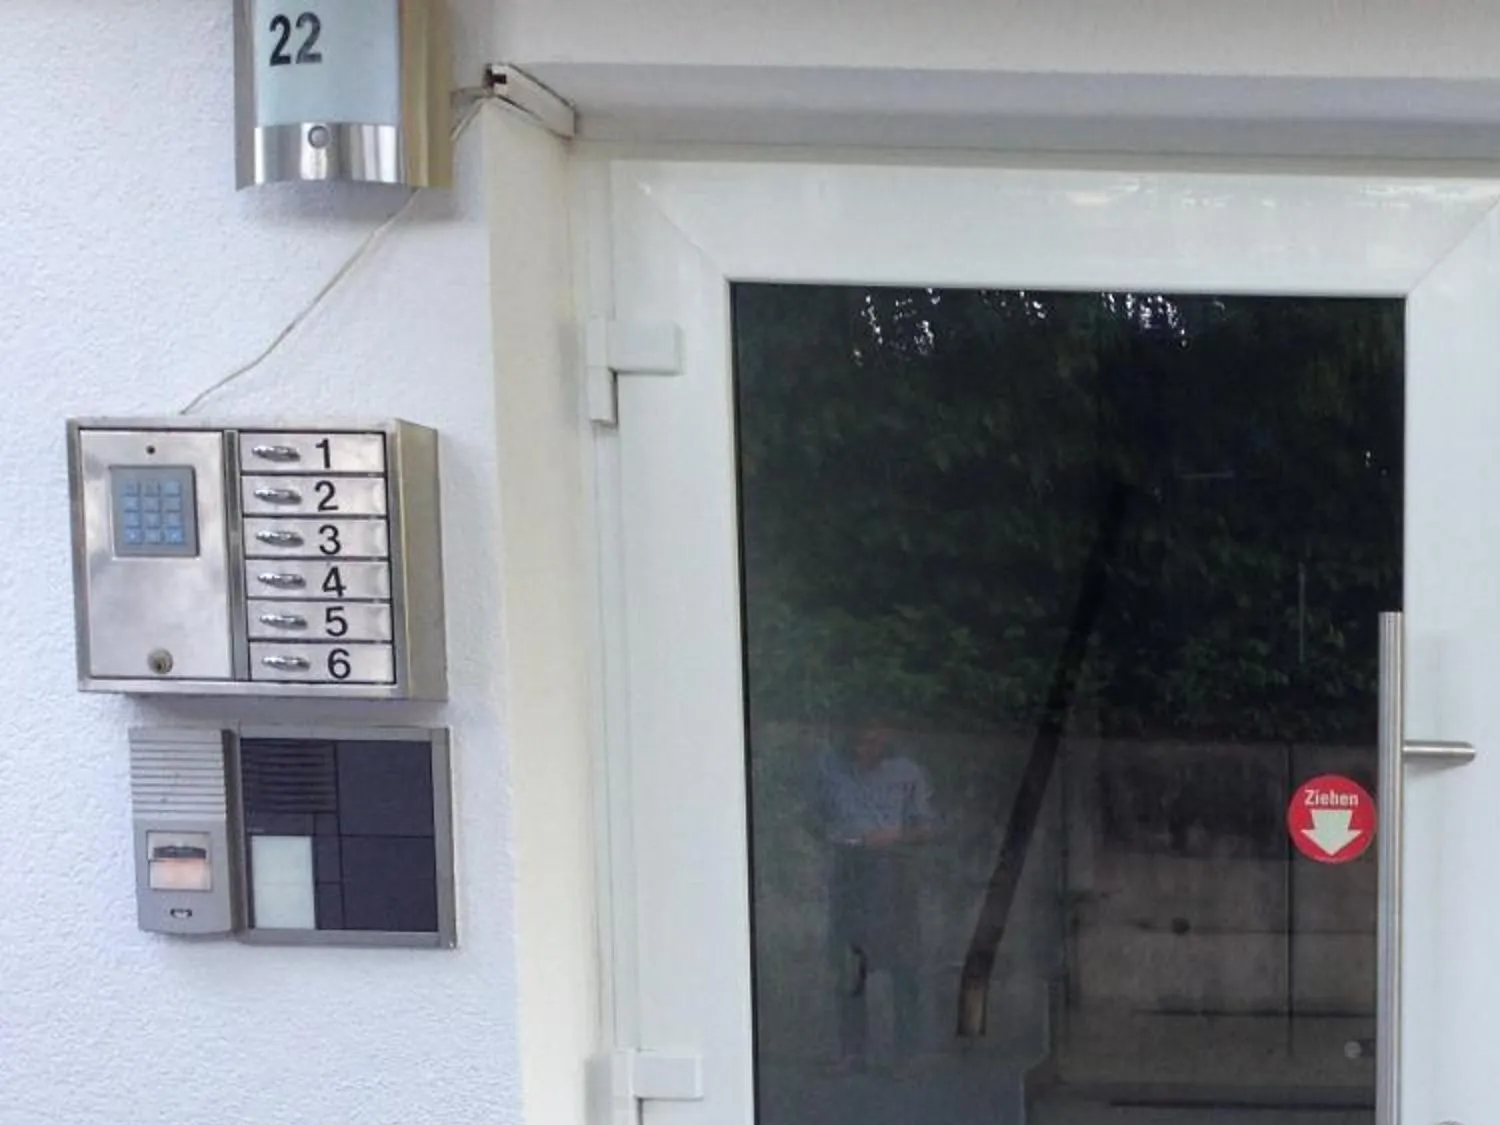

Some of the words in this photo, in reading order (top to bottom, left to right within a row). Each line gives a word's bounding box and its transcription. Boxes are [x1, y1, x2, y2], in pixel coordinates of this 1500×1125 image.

[268, 12, 323, 67] 22
[315, 438, 331, 469] 1
[314, 480, 339, 512] 2
[318, 524, 342, 556] 3
[321, 566, 347, 598] 4
[324, 606, 349, 637] 5
[327, 648, 351, 680] 6
[1303, 788, 1360, 807] Ziehen
